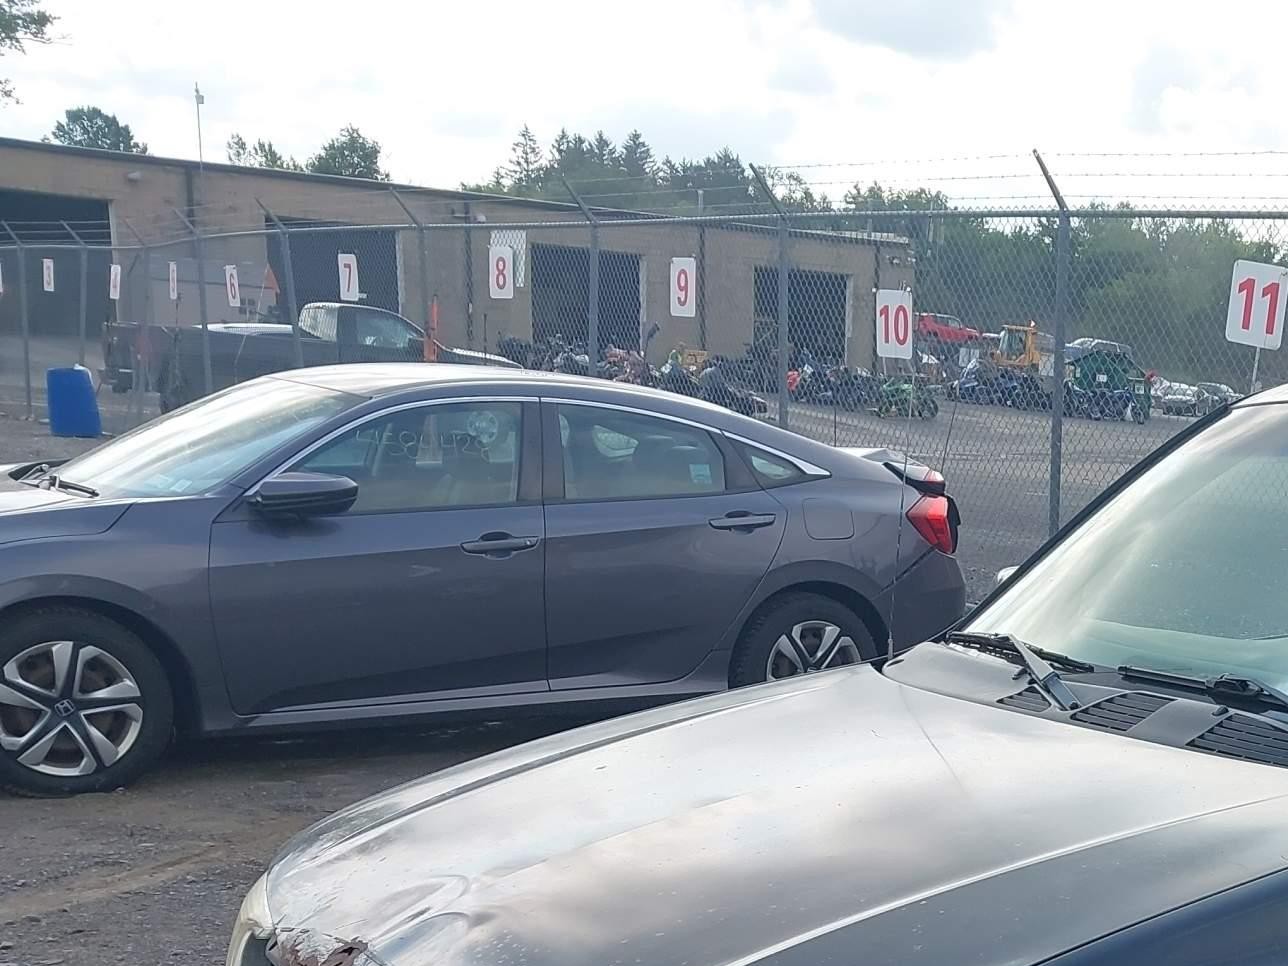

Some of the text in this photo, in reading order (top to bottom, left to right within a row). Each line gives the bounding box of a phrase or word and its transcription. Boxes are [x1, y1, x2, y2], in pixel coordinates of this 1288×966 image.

[229, 273, 237, 300] 6
[343, 263, 352, 292] 7
[495, 256, 507, 290] 8
[676, 268, 689, 307] 9
[1237, 277, 1280, 335] 11
[879, 304, 909, 346] 10
